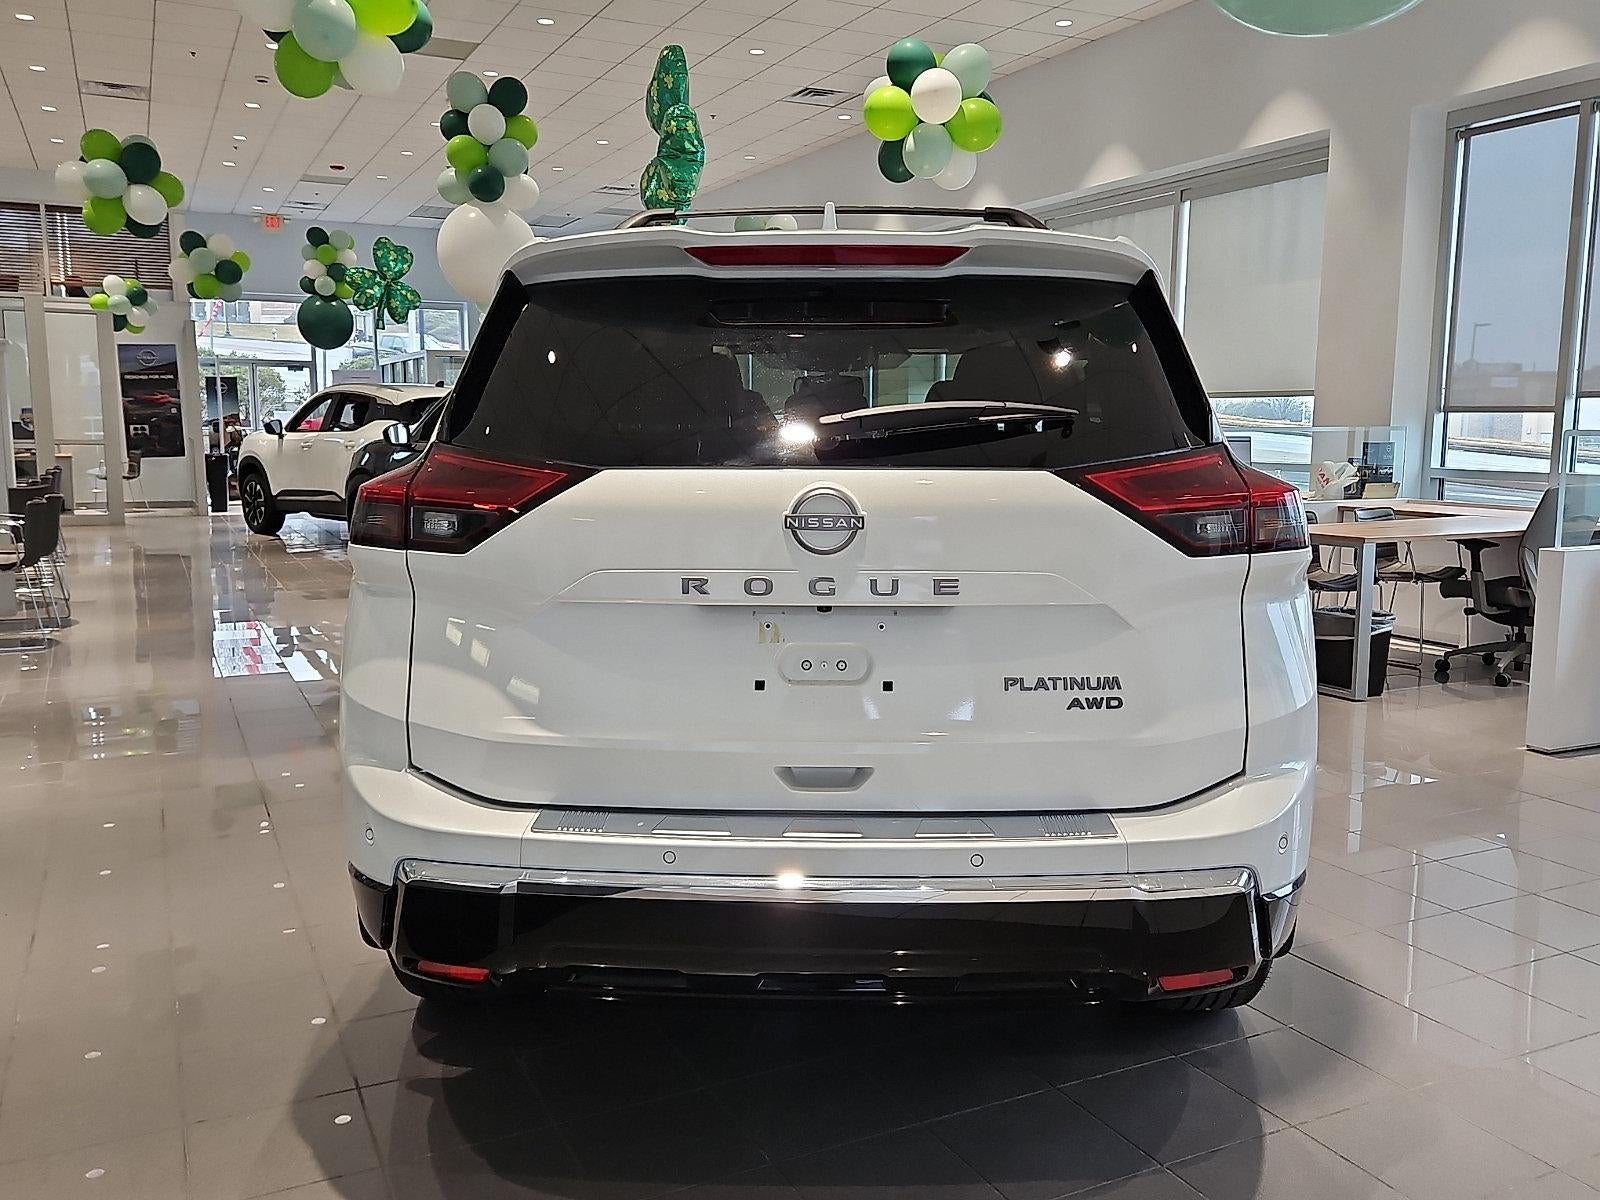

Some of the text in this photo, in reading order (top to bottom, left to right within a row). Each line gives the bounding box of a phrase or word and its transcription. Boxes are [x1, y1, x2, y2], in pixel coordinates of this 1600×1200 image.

[786, 517, 863, 528] NISSAN
[680, 576, 960, 596] ROGUE
[1003, 676, 1122, 691] PLATINUM
[1066, 696, 1124, 710] AWD
